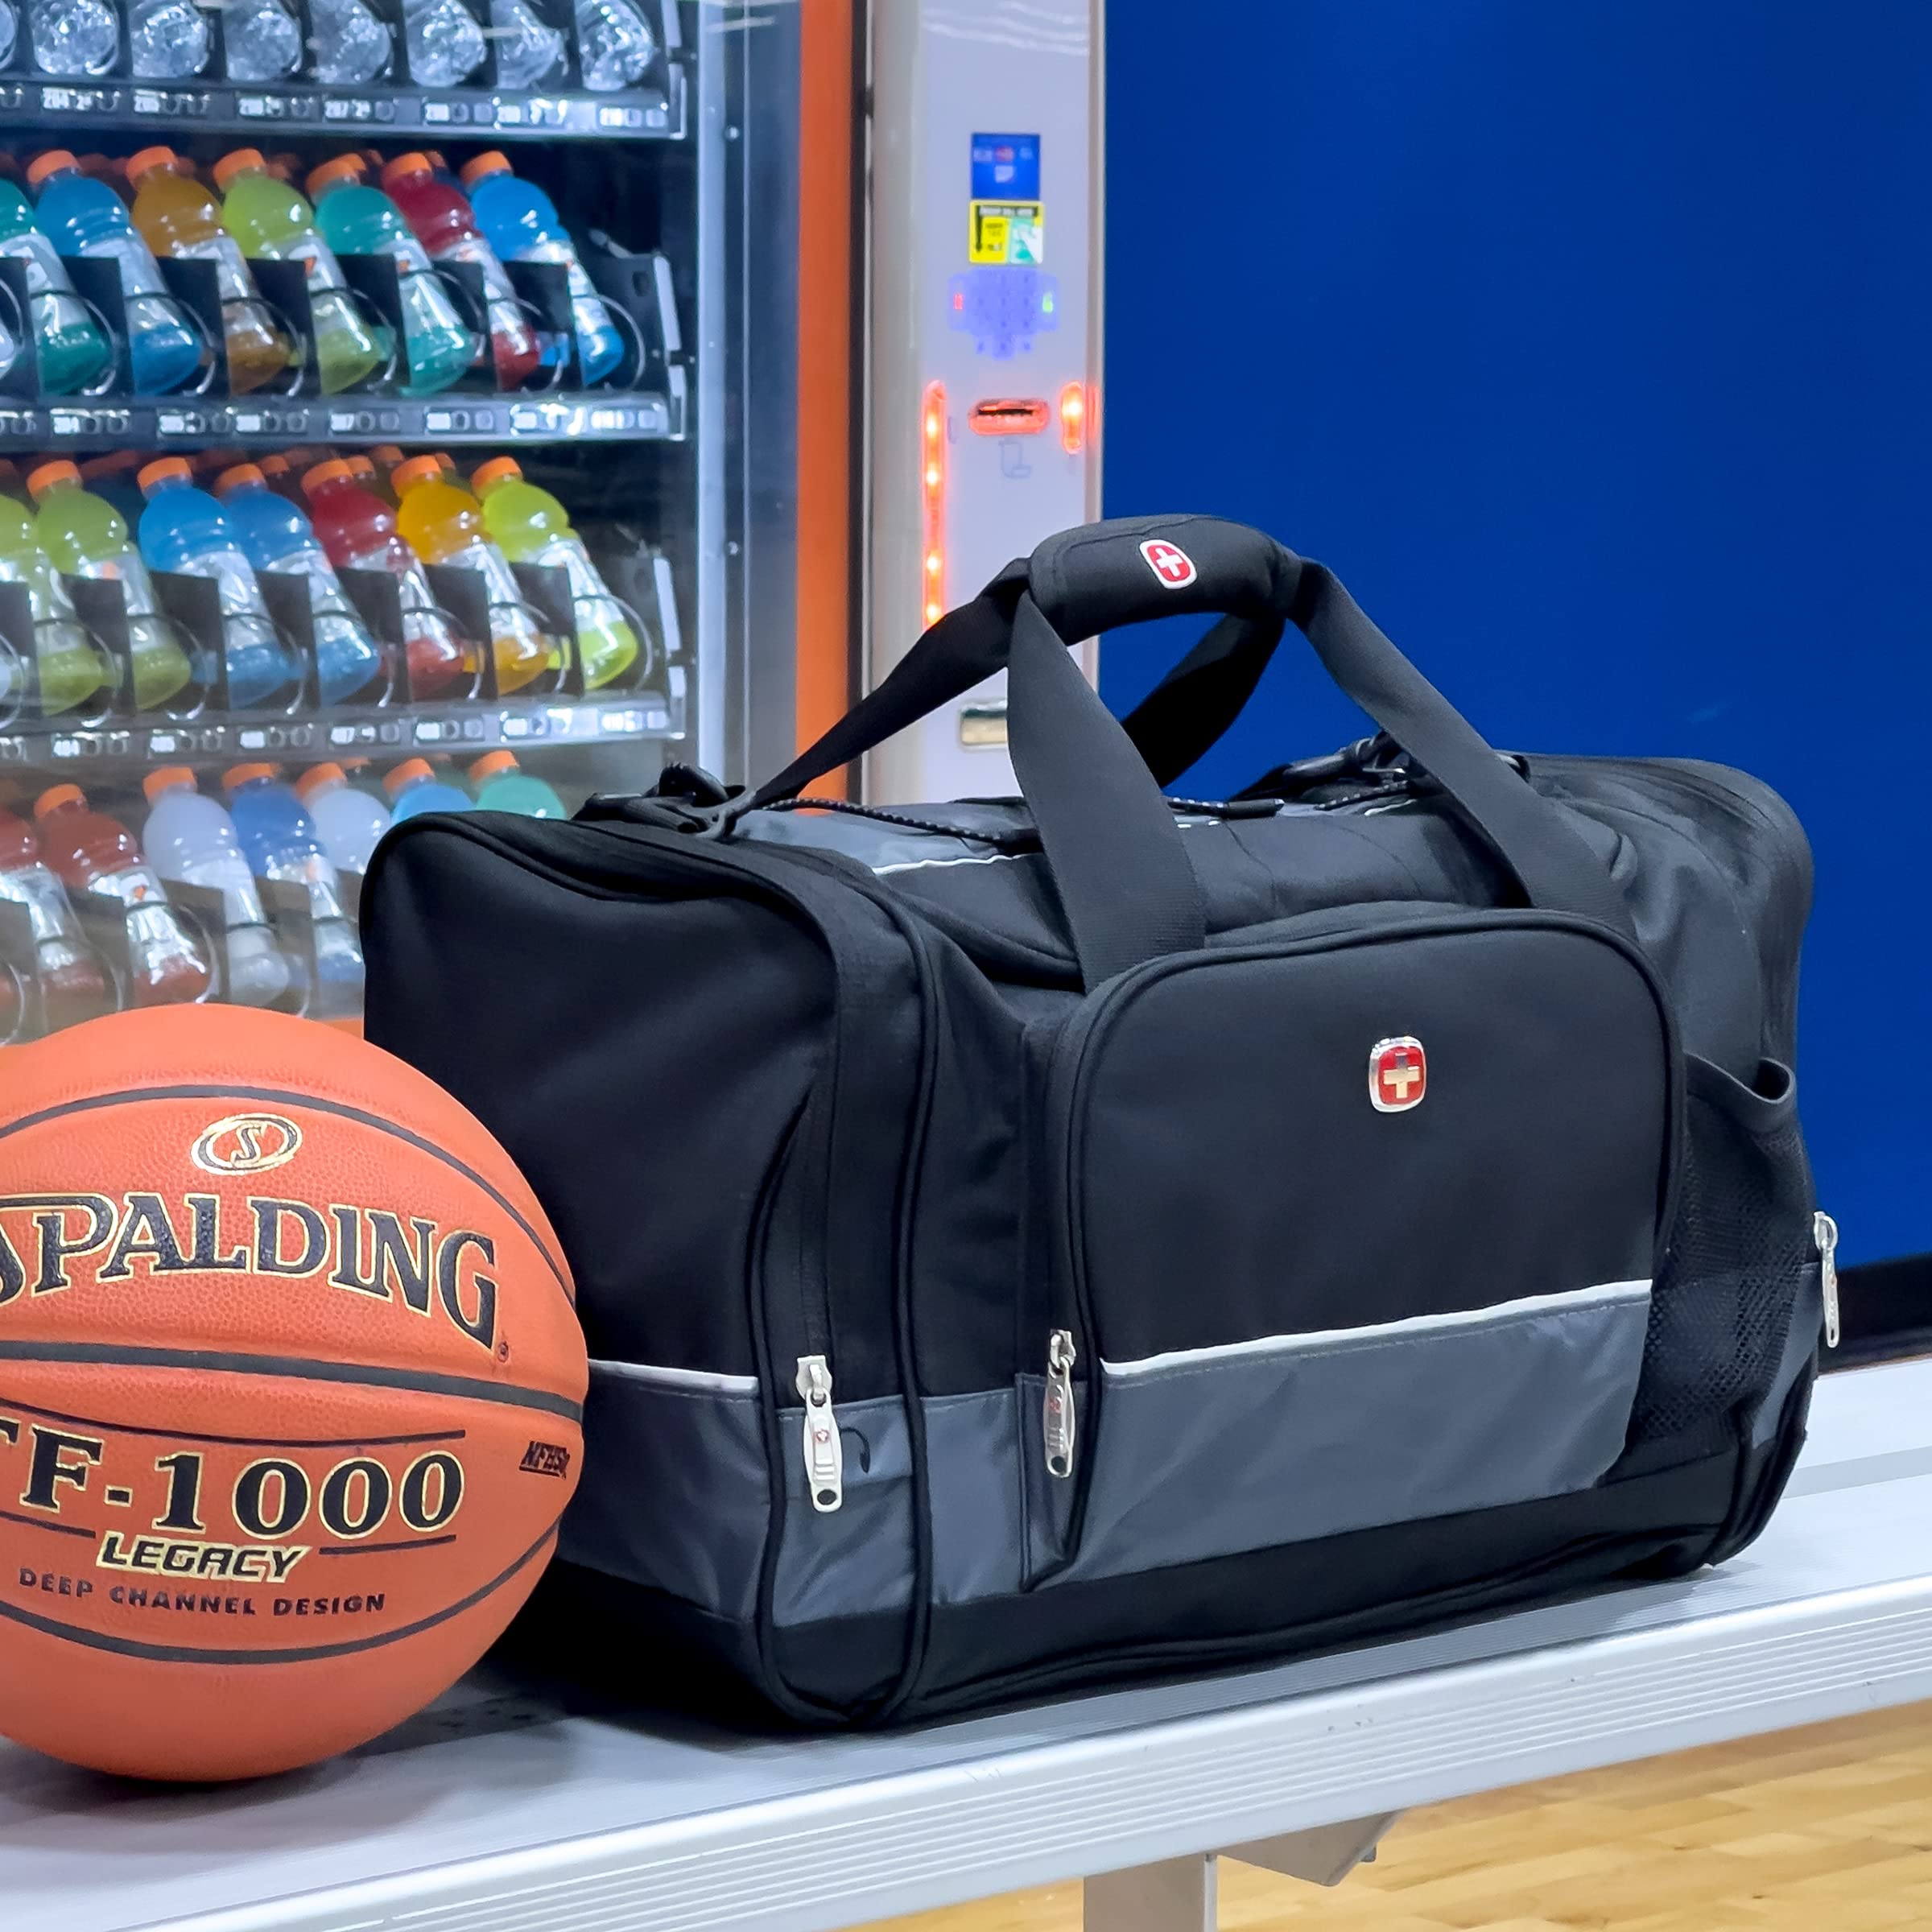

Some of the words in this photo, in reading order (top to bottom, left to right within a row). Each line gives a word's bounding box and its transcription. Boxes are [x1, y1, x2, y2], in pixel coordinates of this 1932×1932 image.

[96, 1530, 312, 1583] LEGACY
[19, 1567, 94, 1598] DEEP
[109, 1585, 256, 1616] CHANNEL
[272, 1593, 386, 1616] DESIGN
